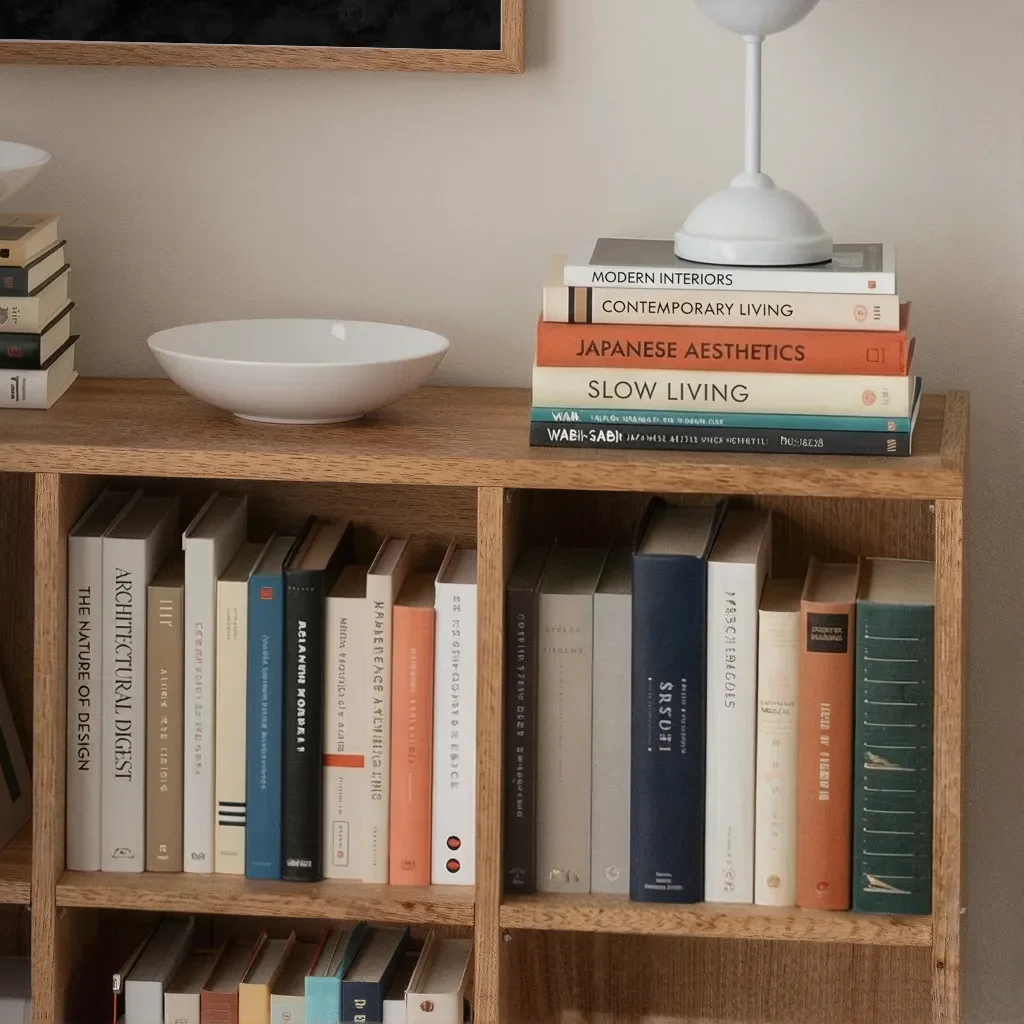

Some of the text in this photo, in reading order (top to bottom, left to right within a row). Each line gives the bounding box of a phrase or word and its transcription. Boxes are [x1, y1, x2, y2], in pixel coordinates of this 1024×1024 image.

[592, 272, 732, 285] MODERN INTERIORS
[603, 301, 793, 316] CONTEMPORARY LIVING
[576, 340, 805, 361] JAPANESE AESTHETICS
[589, 380, 748, 402] SLOW LIVING
[78, 587, 90, 770] THE NATURE OF DESIGN
[115, 568, 132, 781] ARCHITECTURAL DIGEST
